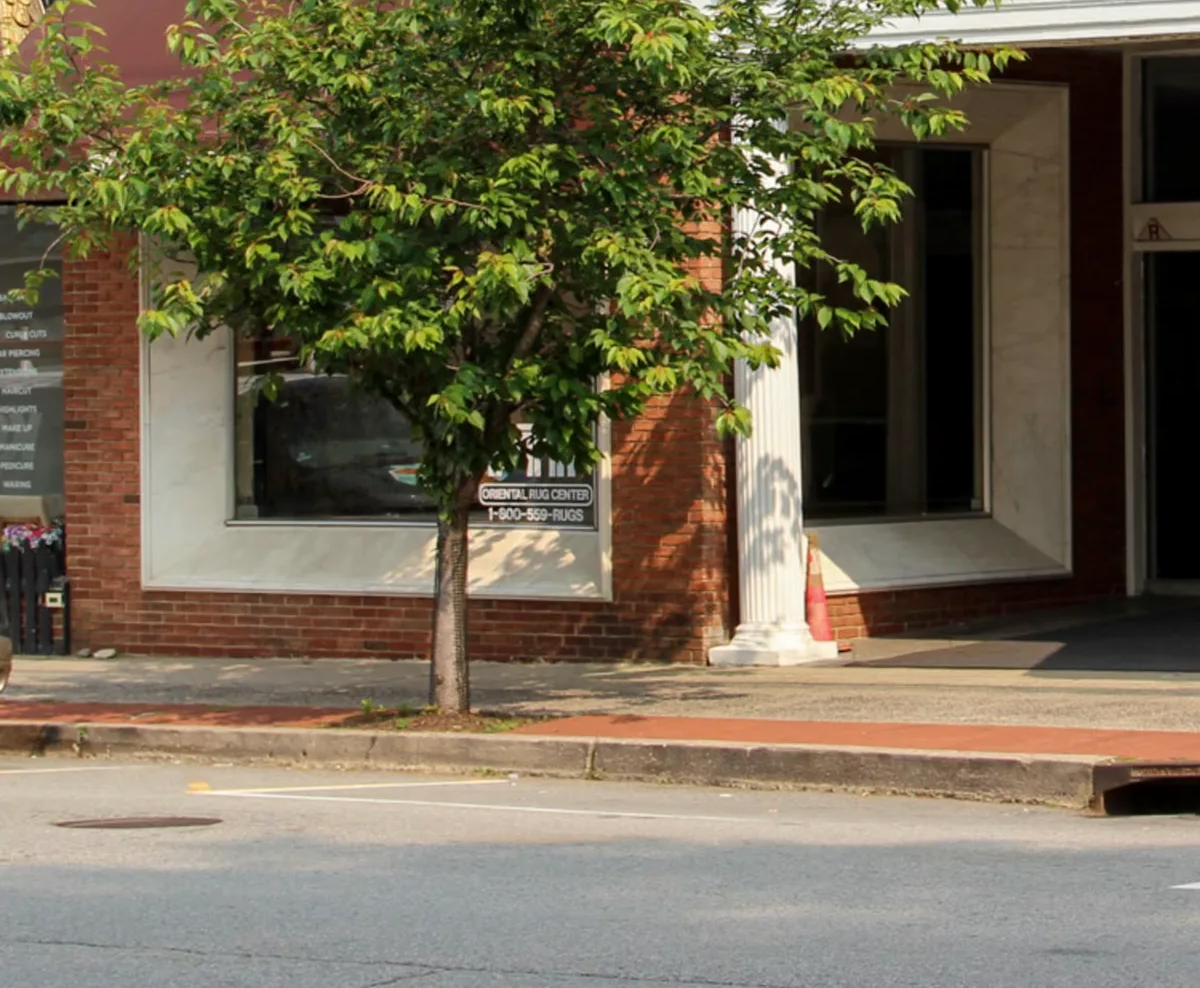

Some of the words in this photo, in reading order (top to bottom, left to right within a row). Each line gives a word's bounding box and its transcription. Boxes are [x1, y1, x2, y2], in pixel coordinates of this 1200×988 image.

[482, 489, 528, 500] ORIENTAL
[529, 489, 550, 500] RUG
[551, 489, 589, 500] CENTER
